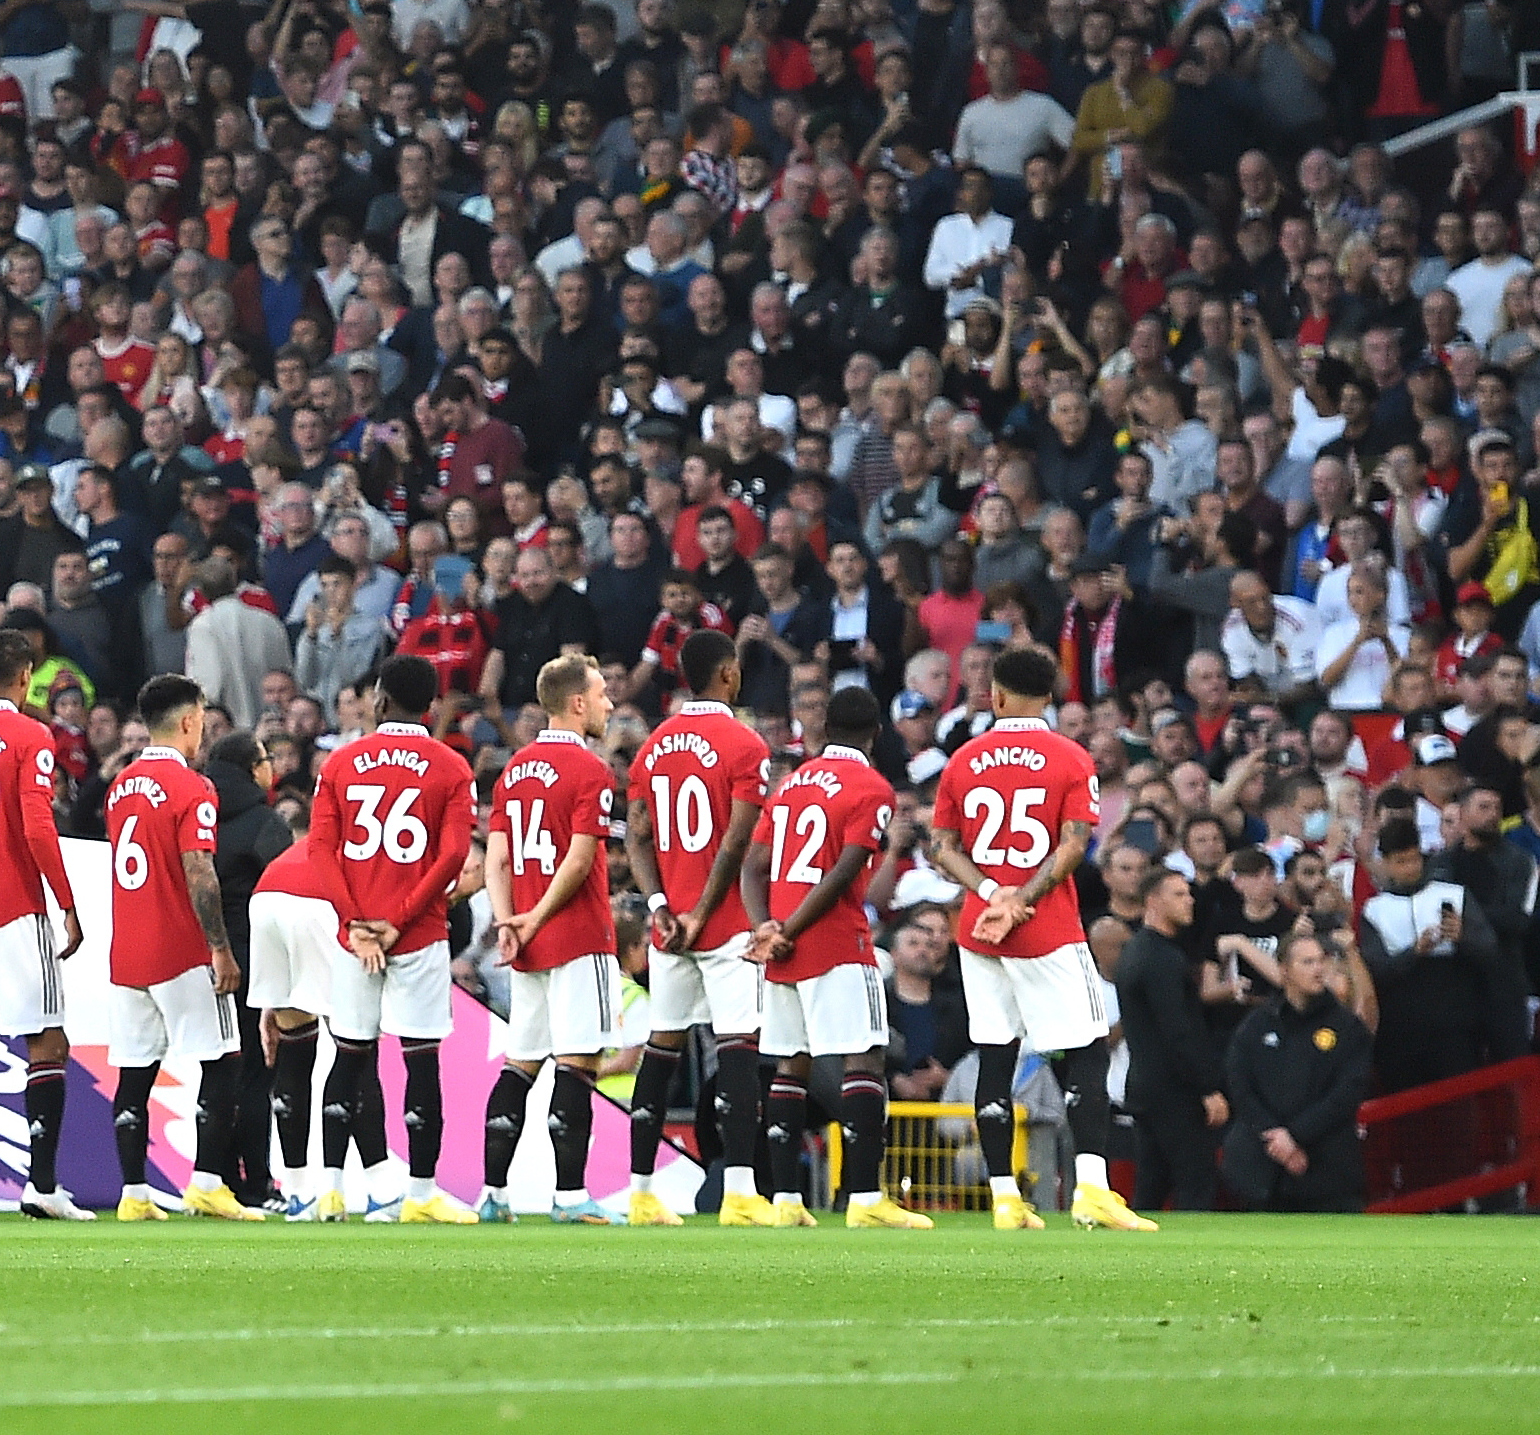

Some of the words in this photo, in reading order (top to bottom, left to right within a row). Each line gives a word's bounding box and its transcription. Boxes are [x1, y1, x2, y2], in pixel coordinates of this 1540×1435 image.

[353, 748, 429, 777] ELANGA
[504, 760, 559, 789] ERIKSEN
[969, 746, 1046, 775] SANCHO
[343, 784, 428, 864] 36
[506, 799, 557, 875] 14
[651, 774, 714, 852] 10
[770, 804, 827, 885] 12
[964, 786, 1050, 868] 25
[115, 815, 148, 890] 6
